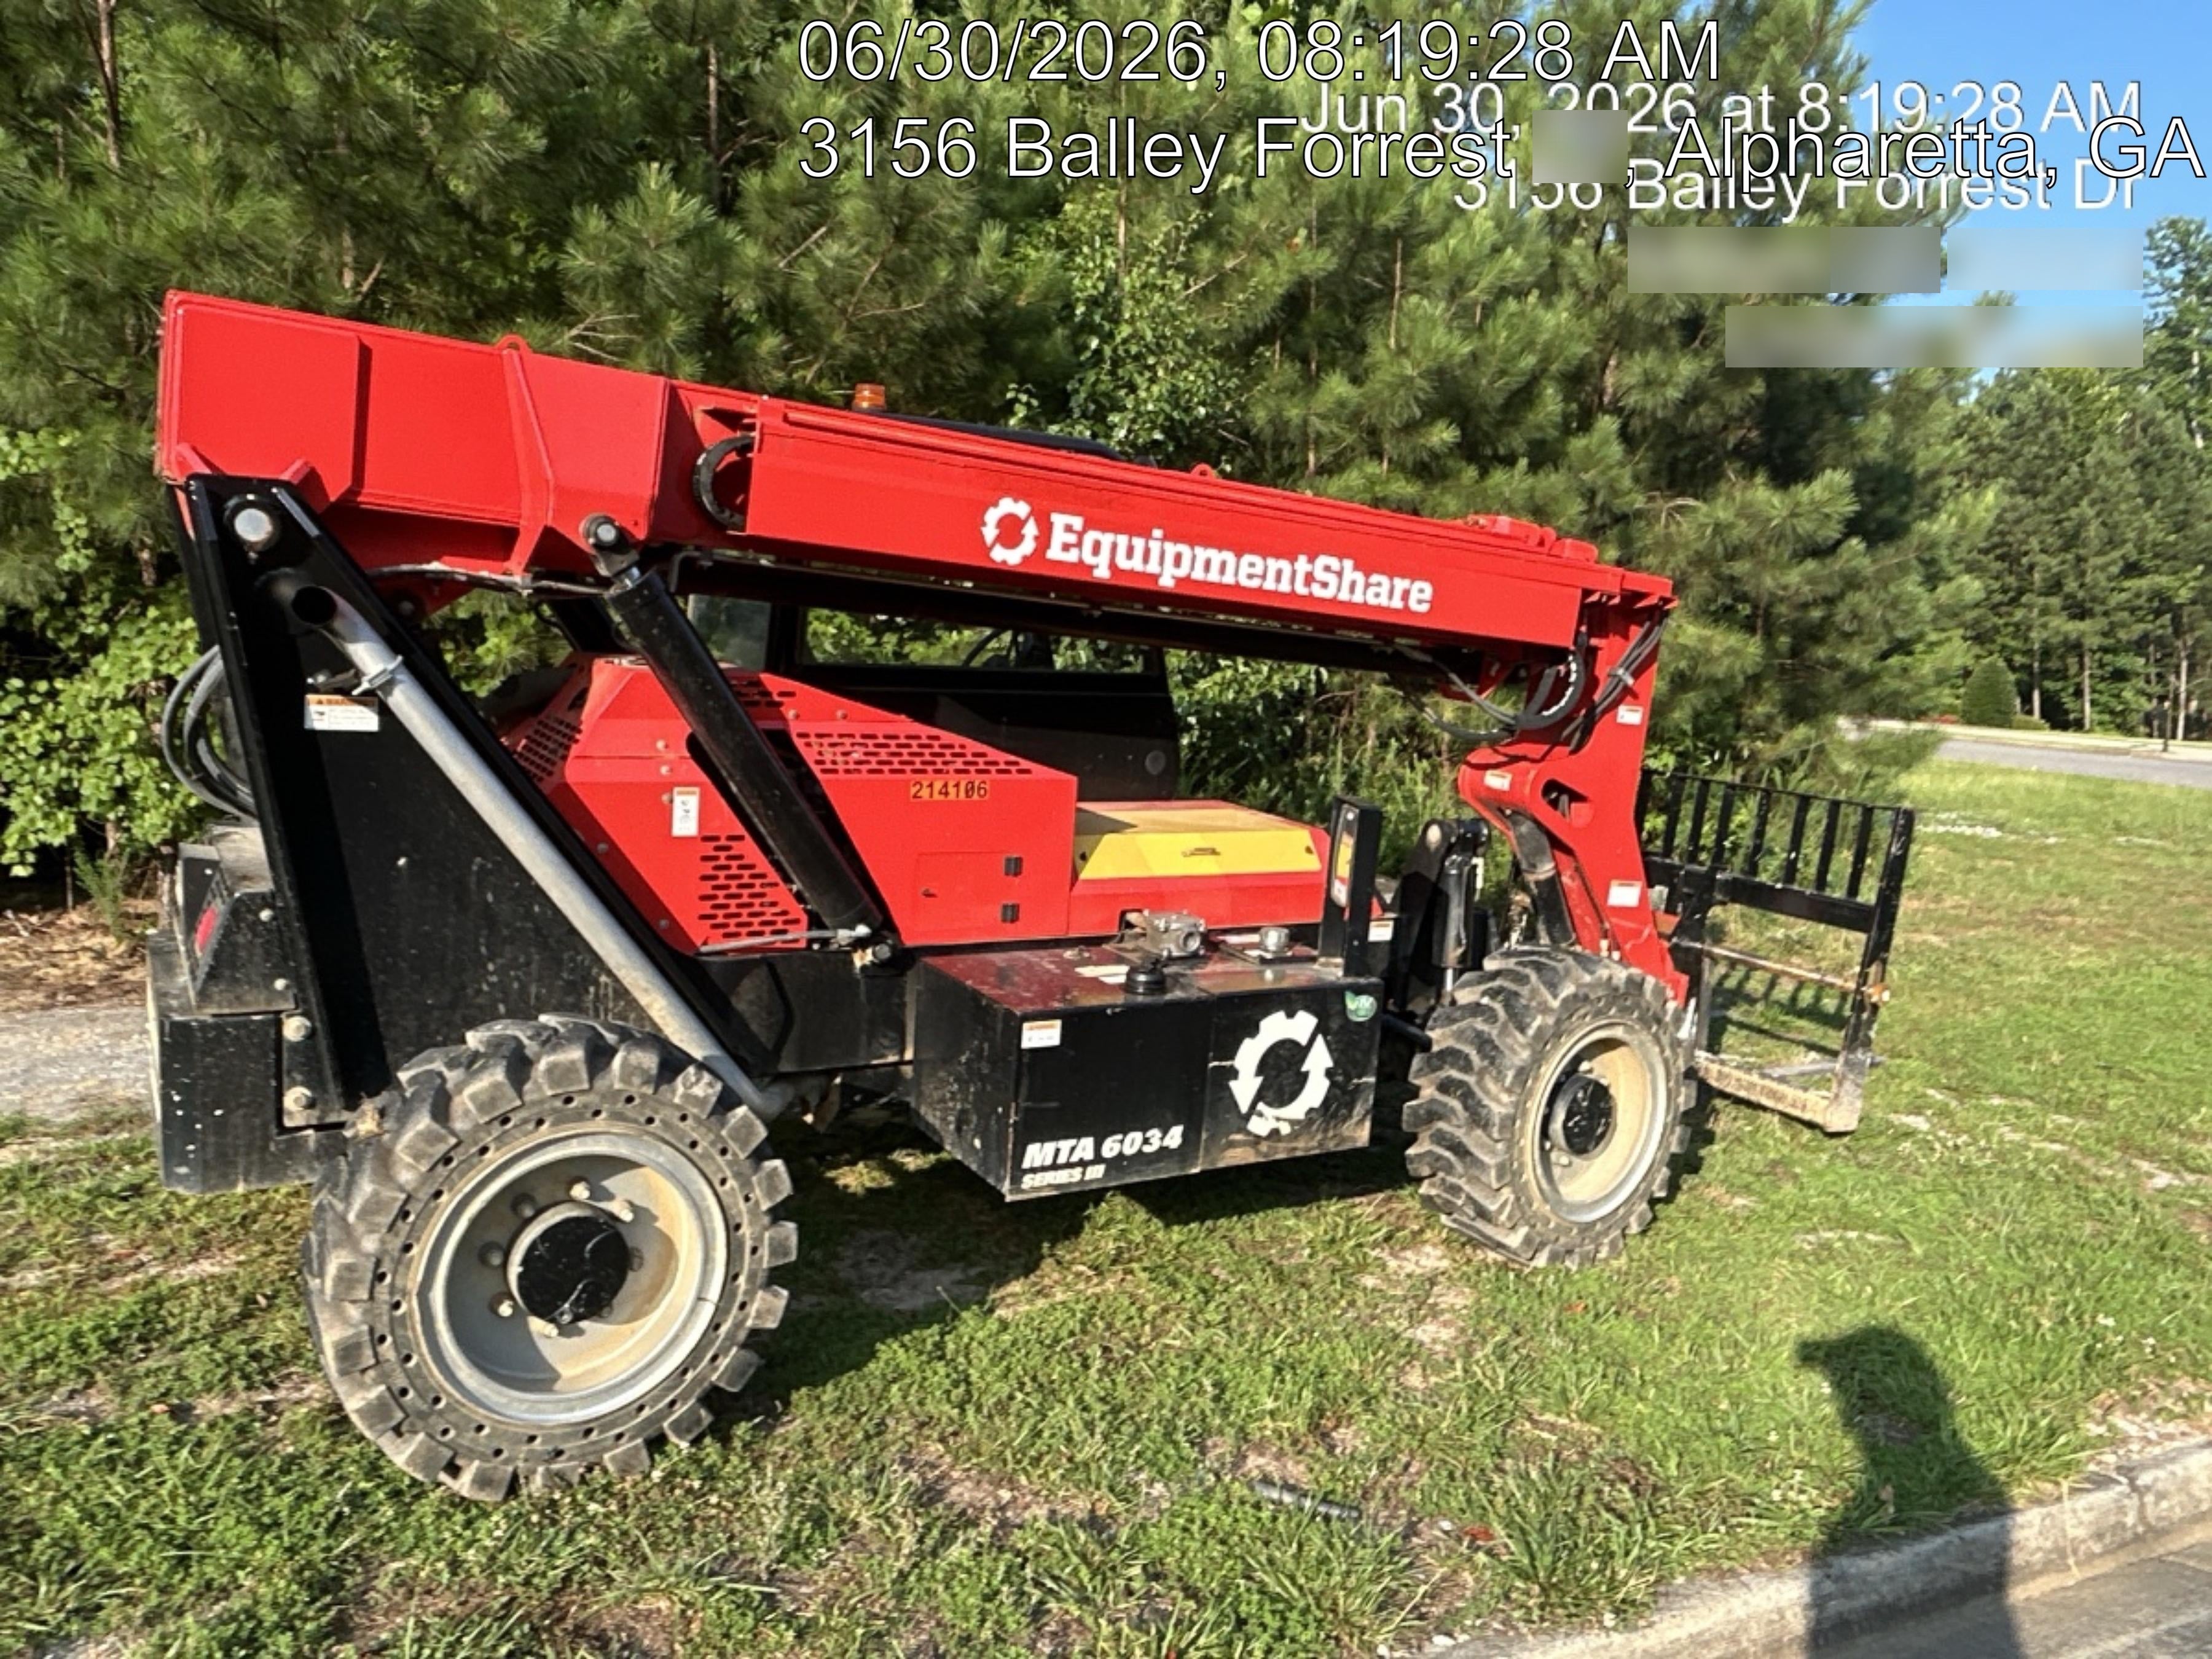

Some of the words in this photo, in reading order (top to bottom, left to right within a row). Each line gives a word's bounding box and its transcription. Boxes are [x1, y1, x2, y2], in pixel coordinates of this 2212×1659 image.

[1046, 511, 1434, 613] EquipmentShare
[1021, 1137, 1094, 1169] MTA
[1101, 1124, 1184, 1158] 6034
